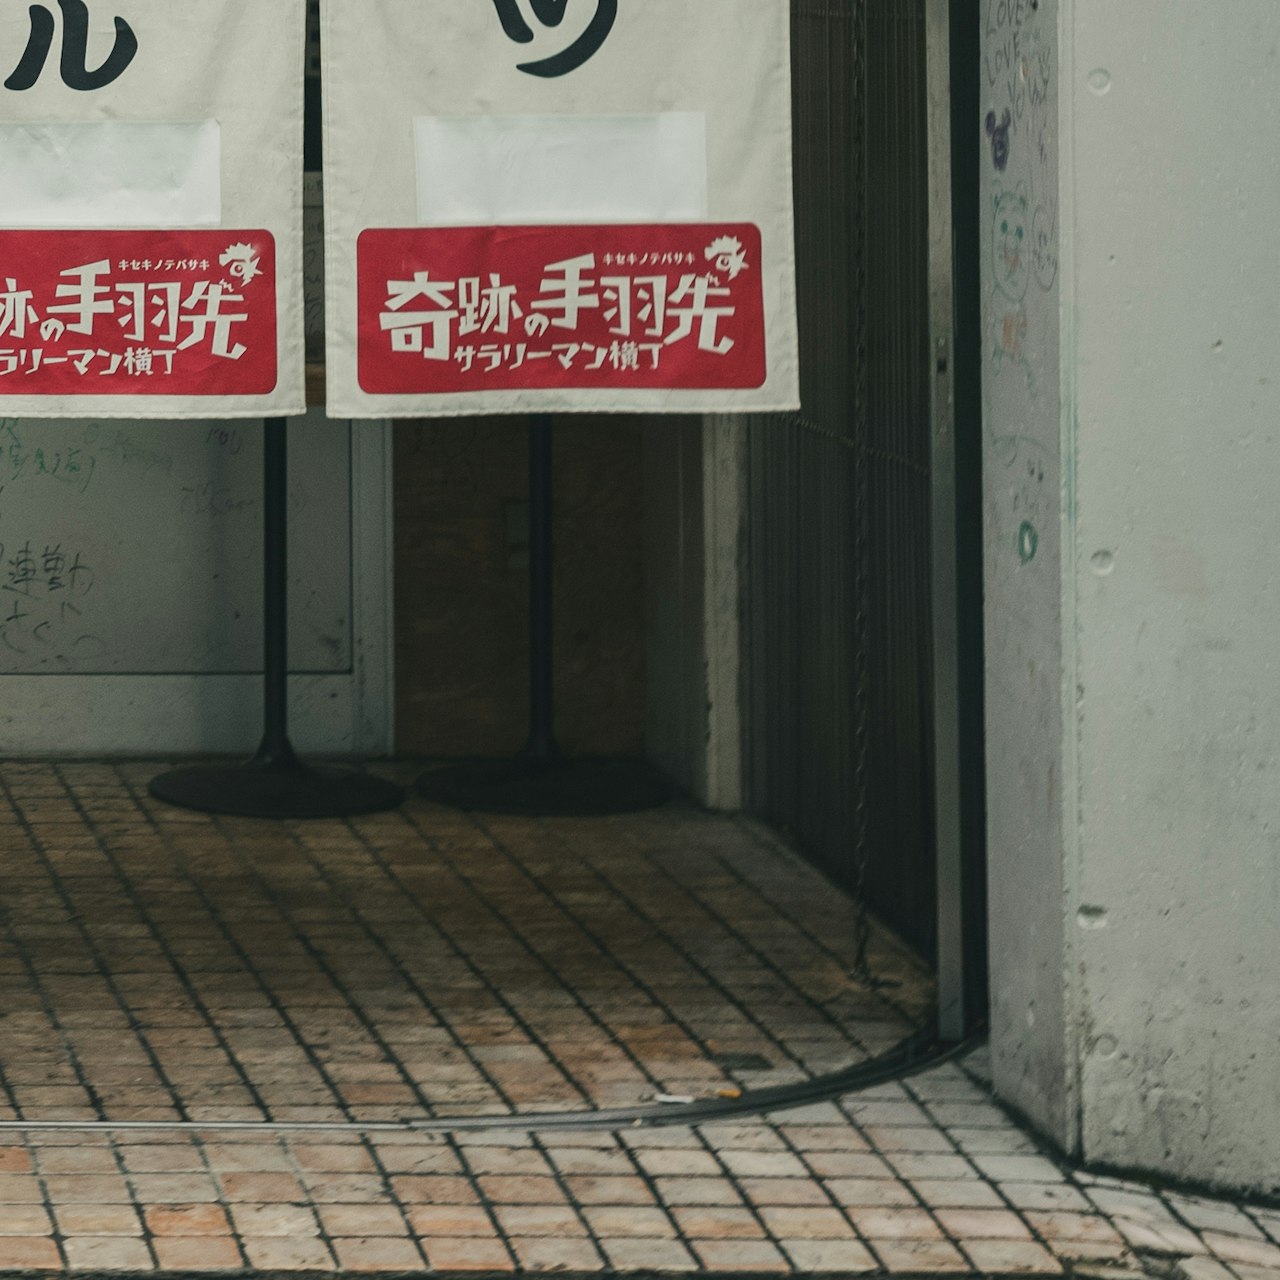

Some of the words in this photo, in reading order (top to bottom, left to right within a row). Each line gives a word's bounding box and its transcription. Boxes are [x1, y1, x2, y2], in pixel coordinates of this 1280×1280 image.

[117, 257, 211, 272] キセキノテバサキ
[602, 251, 697, 266] キセキノテバサキ
[379, 255, 737, 363] 奇跡の手羽先
[453, 340, 666, 373] サラリーマン横丁
